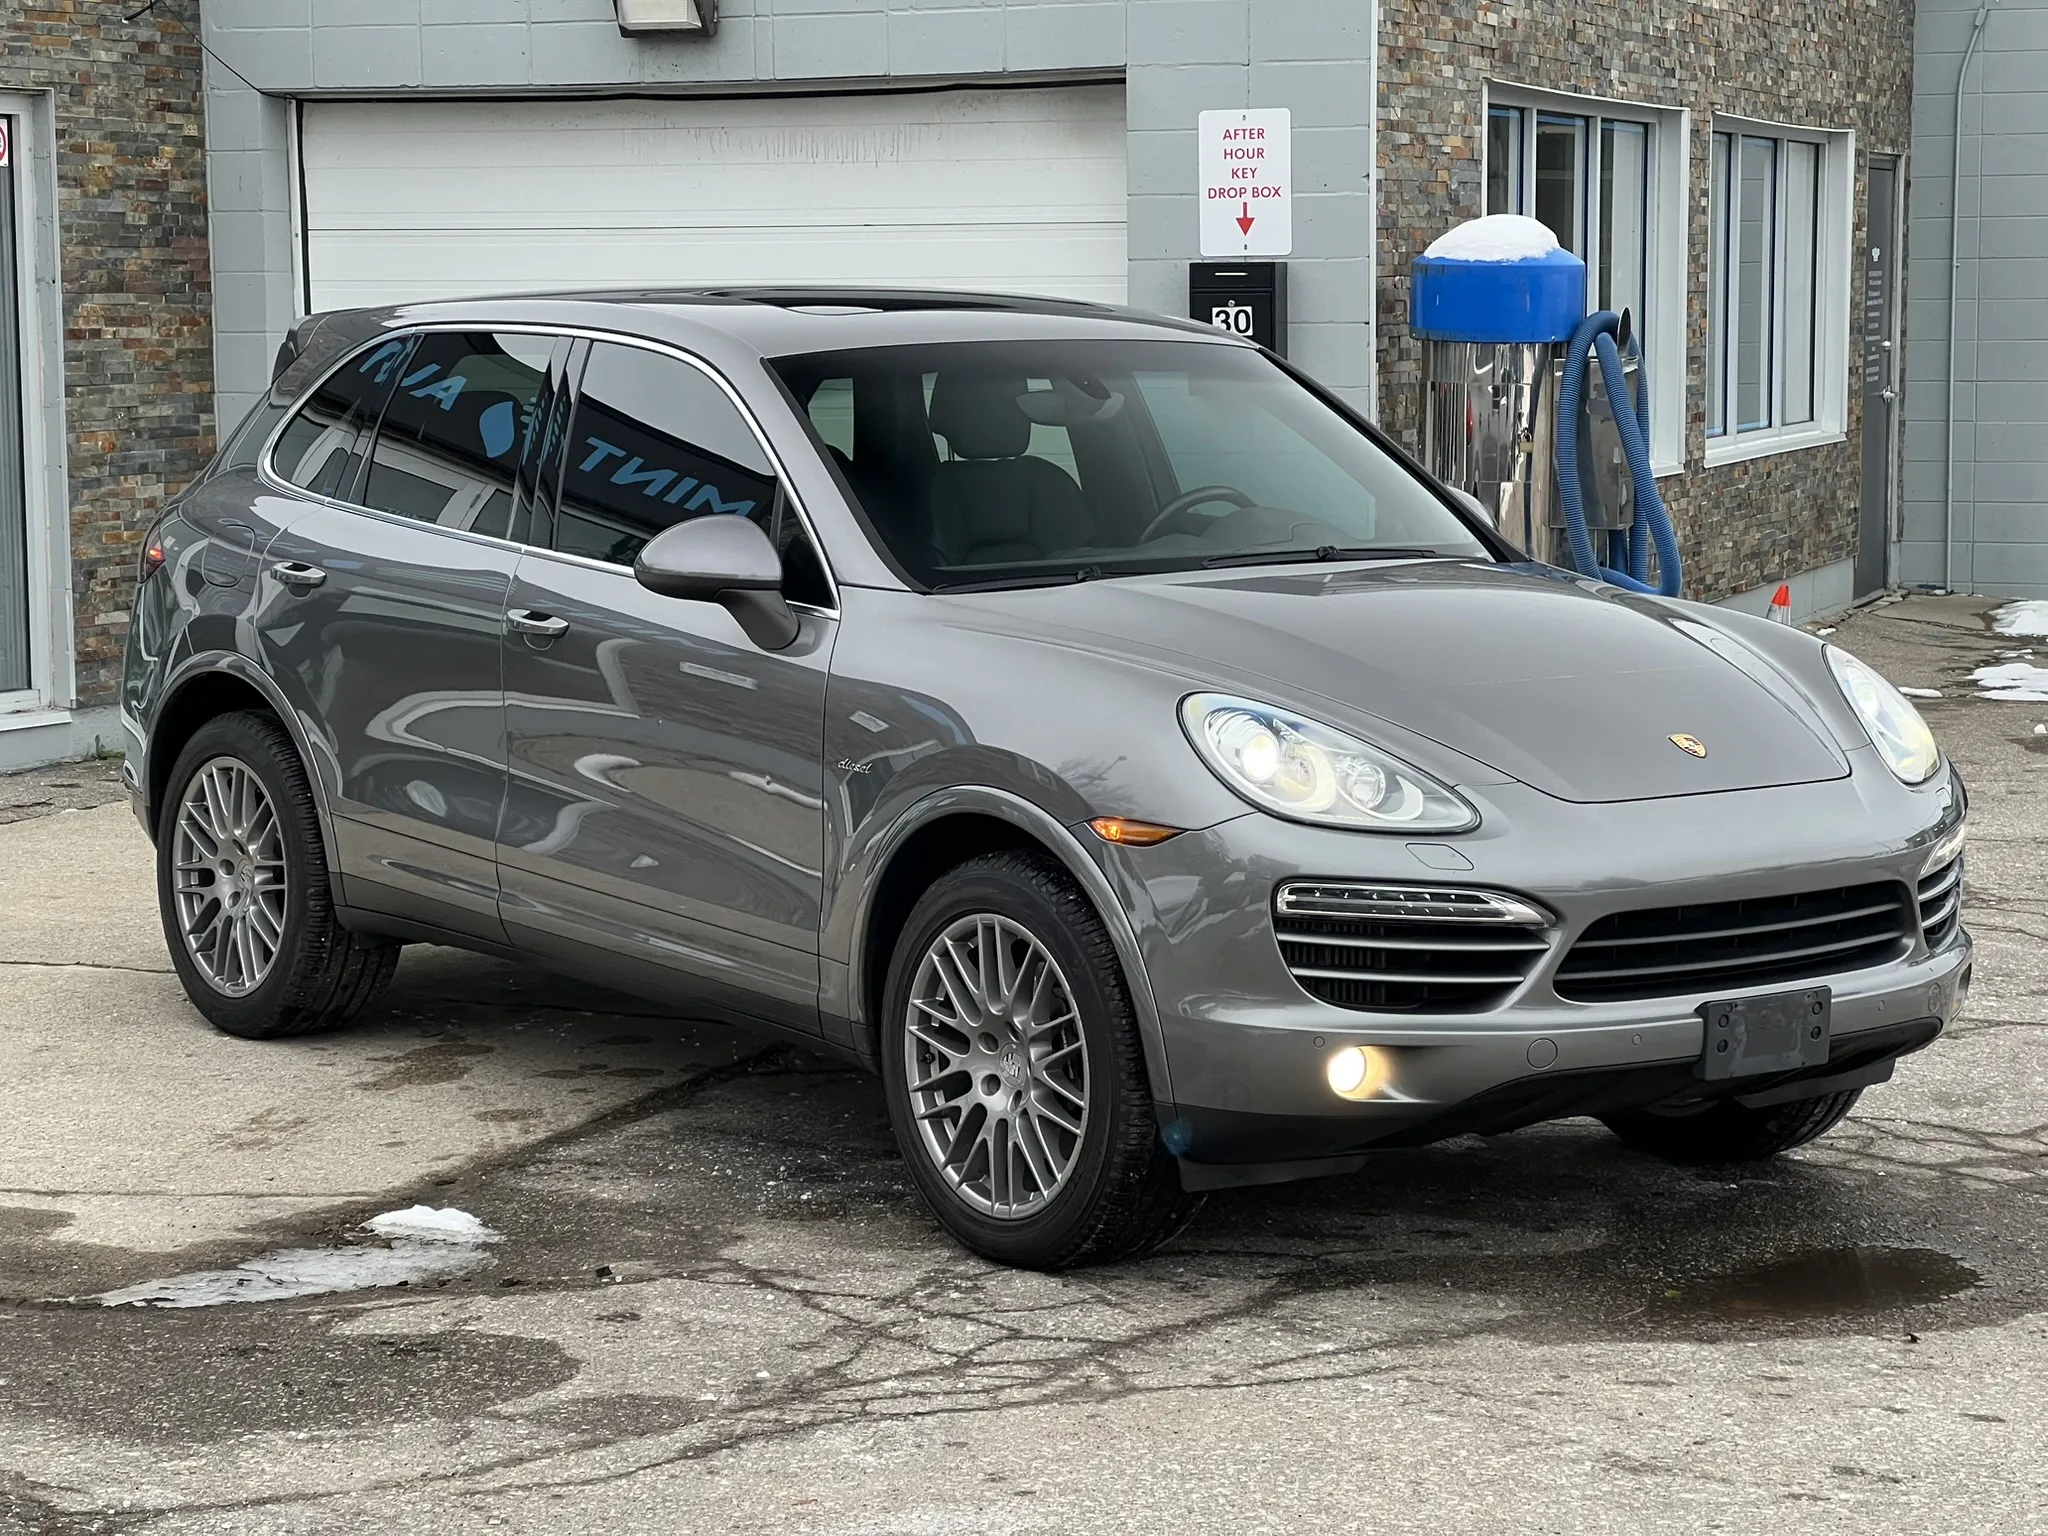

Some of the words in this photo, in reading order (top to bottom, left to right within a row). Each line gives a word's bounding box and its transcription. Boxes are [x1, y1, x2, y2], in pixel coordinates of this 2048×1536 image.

[1222, 128, 1265, 141] AFTER
[1223, 148, 1265, 160] HOUR
[1231, 168, 1258, 179] KEY
[1207, 187, 1247, 199] DROP
[1252, 186, 1282, 198] BOX
[1214, 309, 1252, 334] 30
[837, 758, 873, 774] diesel
